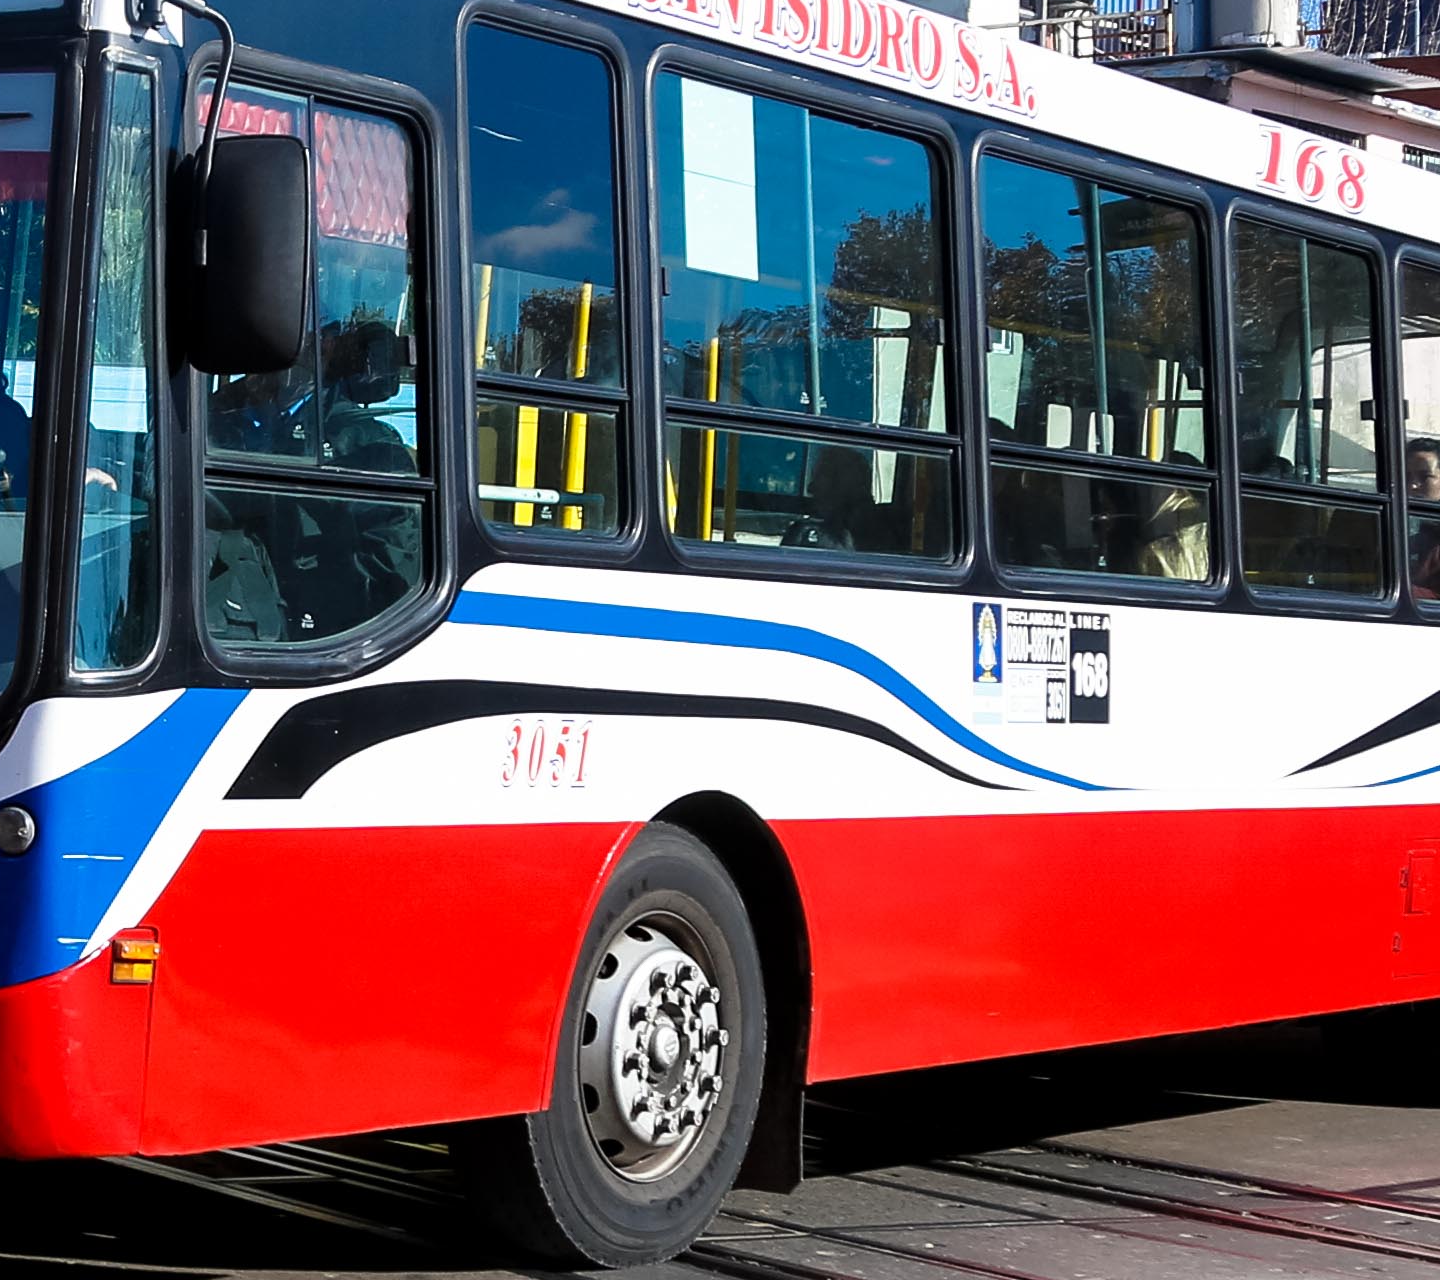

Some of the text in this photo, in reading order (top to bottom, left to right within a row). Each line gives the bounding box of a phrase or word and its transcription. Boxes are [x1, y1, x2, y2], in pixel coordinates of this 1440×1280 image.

[955, 24, 1038, 117] S.A.
[1257, 125, 1367, 214] 168
[1069, 614, 1111, 630] LINEA
[1072, 651, 1109, 698] 168
[501, 719, 592, 787] 3051
